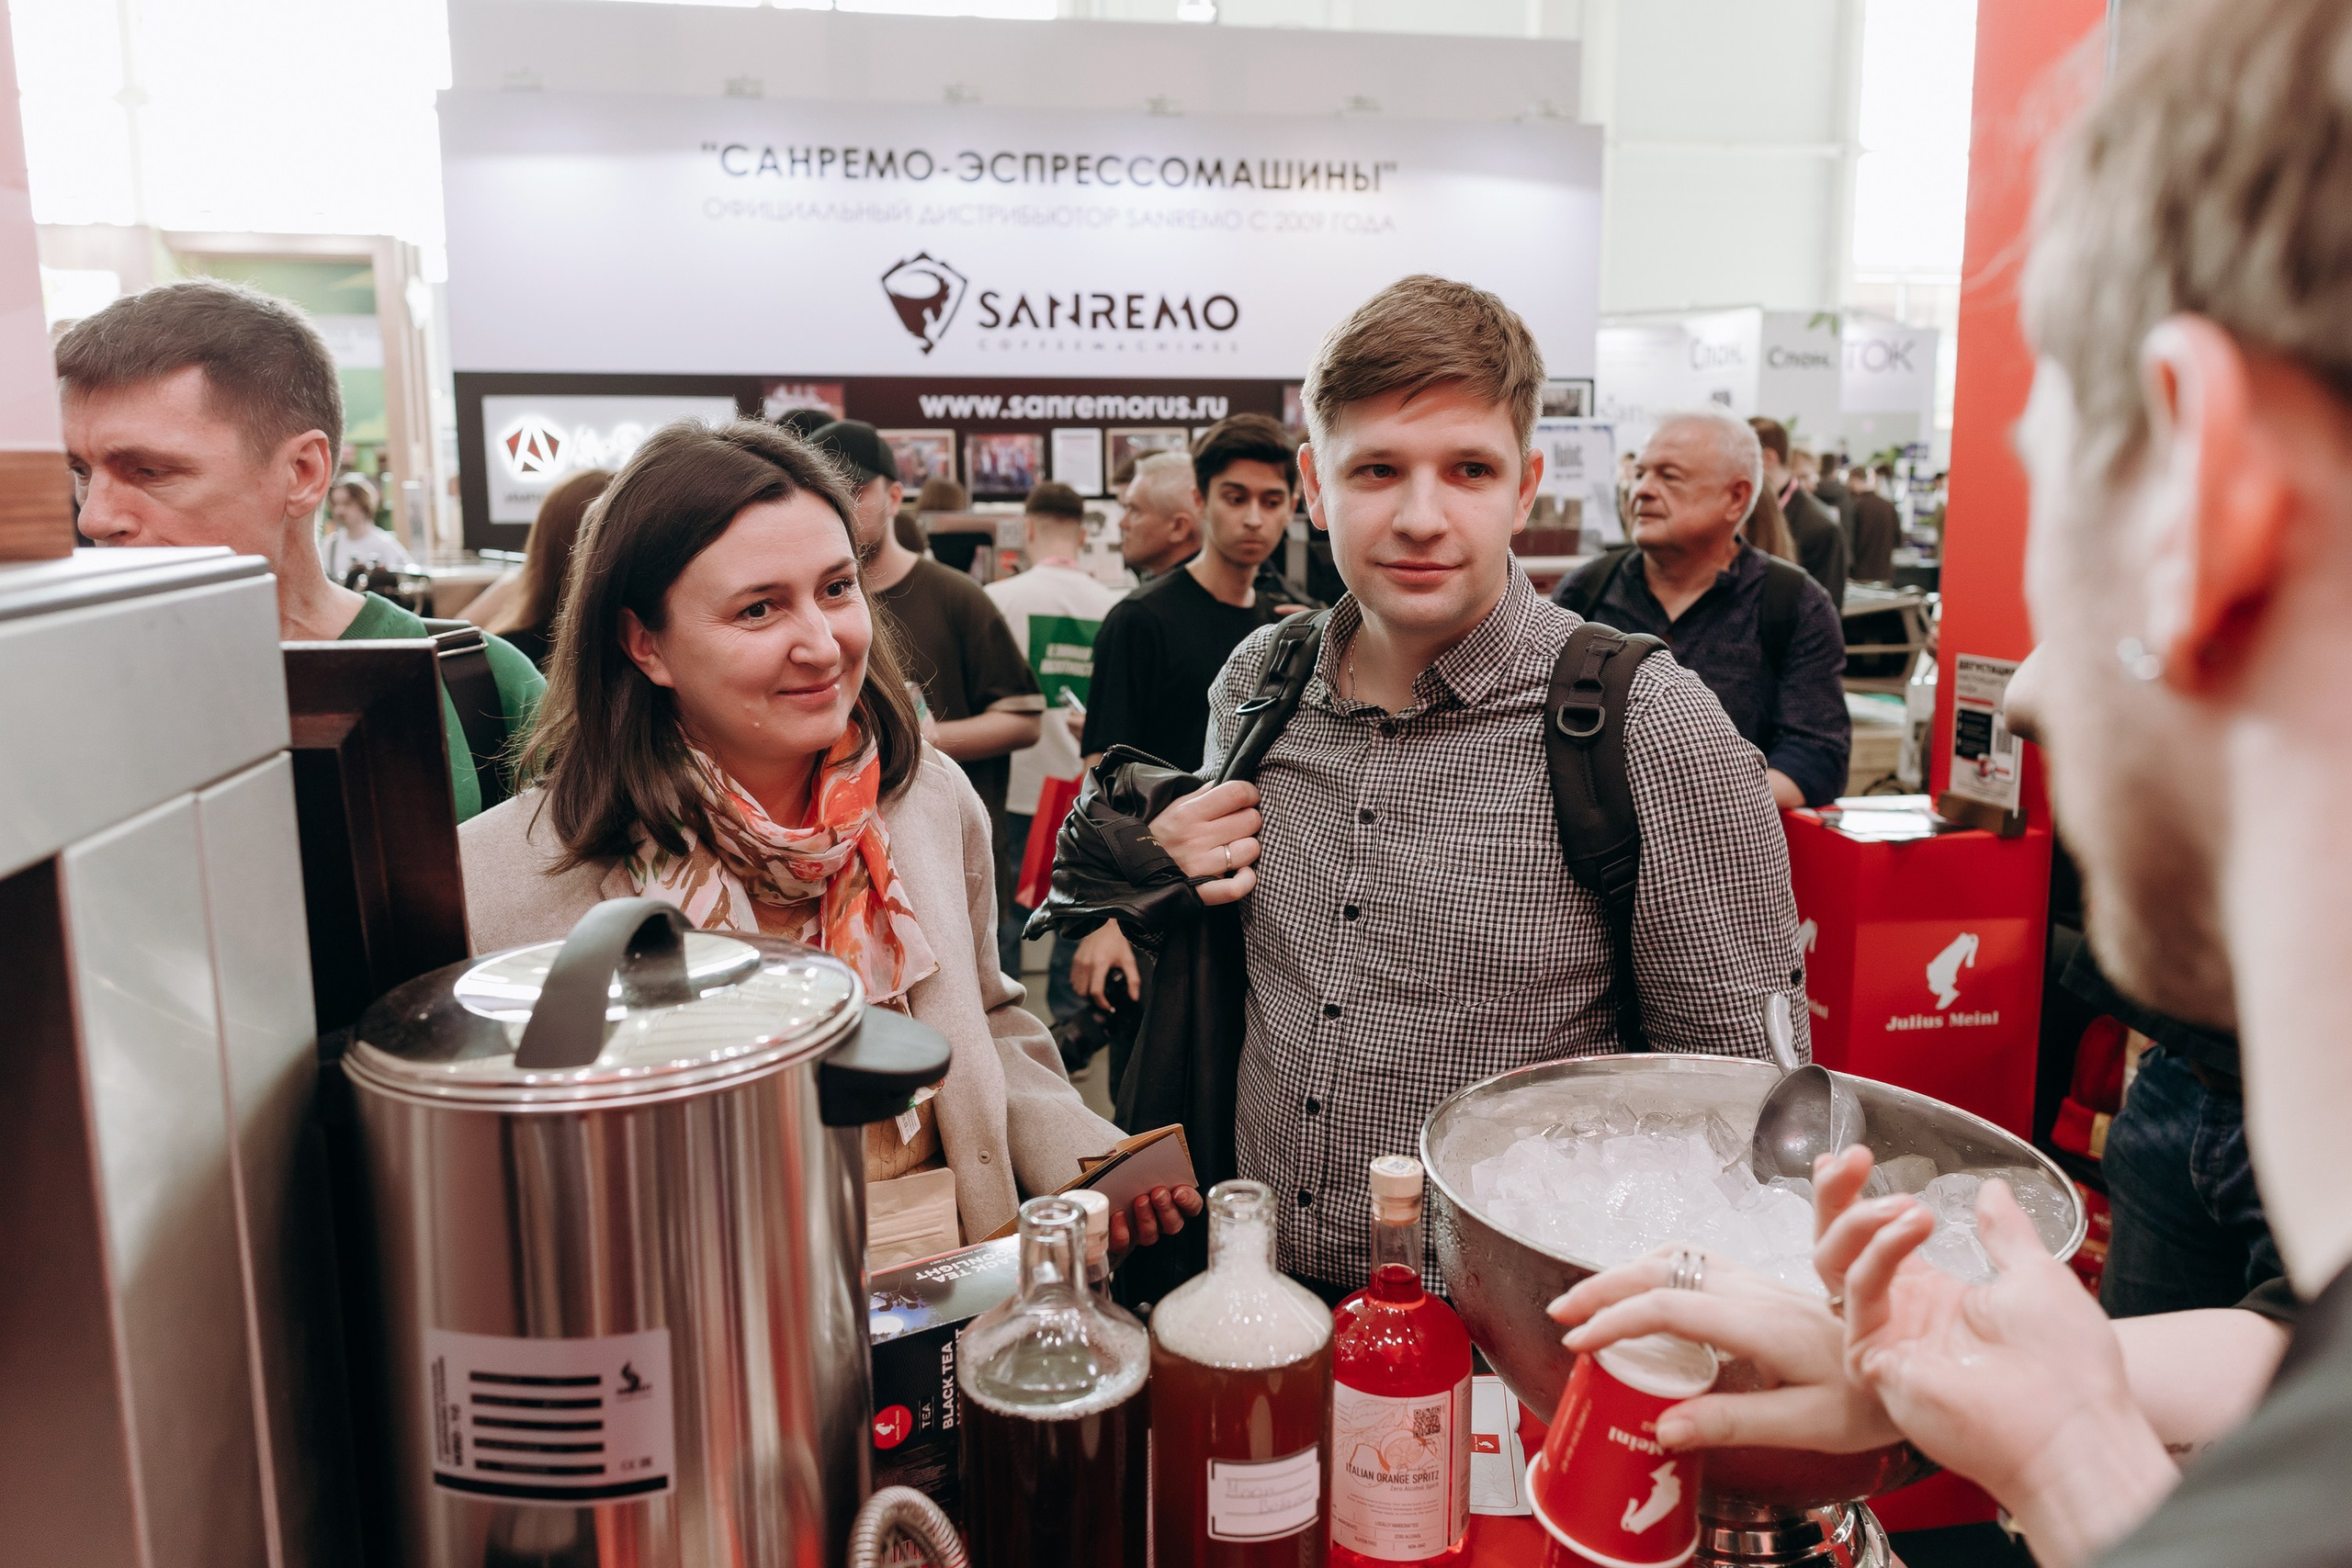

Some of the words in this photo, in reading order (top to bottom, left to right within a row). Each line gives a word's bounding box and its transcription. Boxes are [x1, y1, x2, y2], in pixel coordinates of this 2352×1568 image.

[700, 141, 1397, 191] "САНРЕМО-ЭСПРЕССОМАШИНЫ"
[1330, 209, 1399, 235] ГОДА
[978, 290, 1238, 331] SANREMO
[919, 394, 1229, 420] www.sanremorus.ru
[1885, 1014, 1944, 1032] Julius
[1949, 1010, 1999, 1028] Meinl
[931, 1267, 971, 1283] TEA
[970, 1253, 1019, 1273] LACK
[941, 1340, 955, 1375] TEA
[942, 1374, 955, 1430] BLACK
[922, 1402, 932, 1429] TEA
[1345, 1461, 1374, 1482] ITALIAN
[1376, 1472, 1410, 1484] ORANGE
[1412, 1470, 1440, 1484] SPRITZ
[1404, 1483, 1425, 1492] Alcohol
